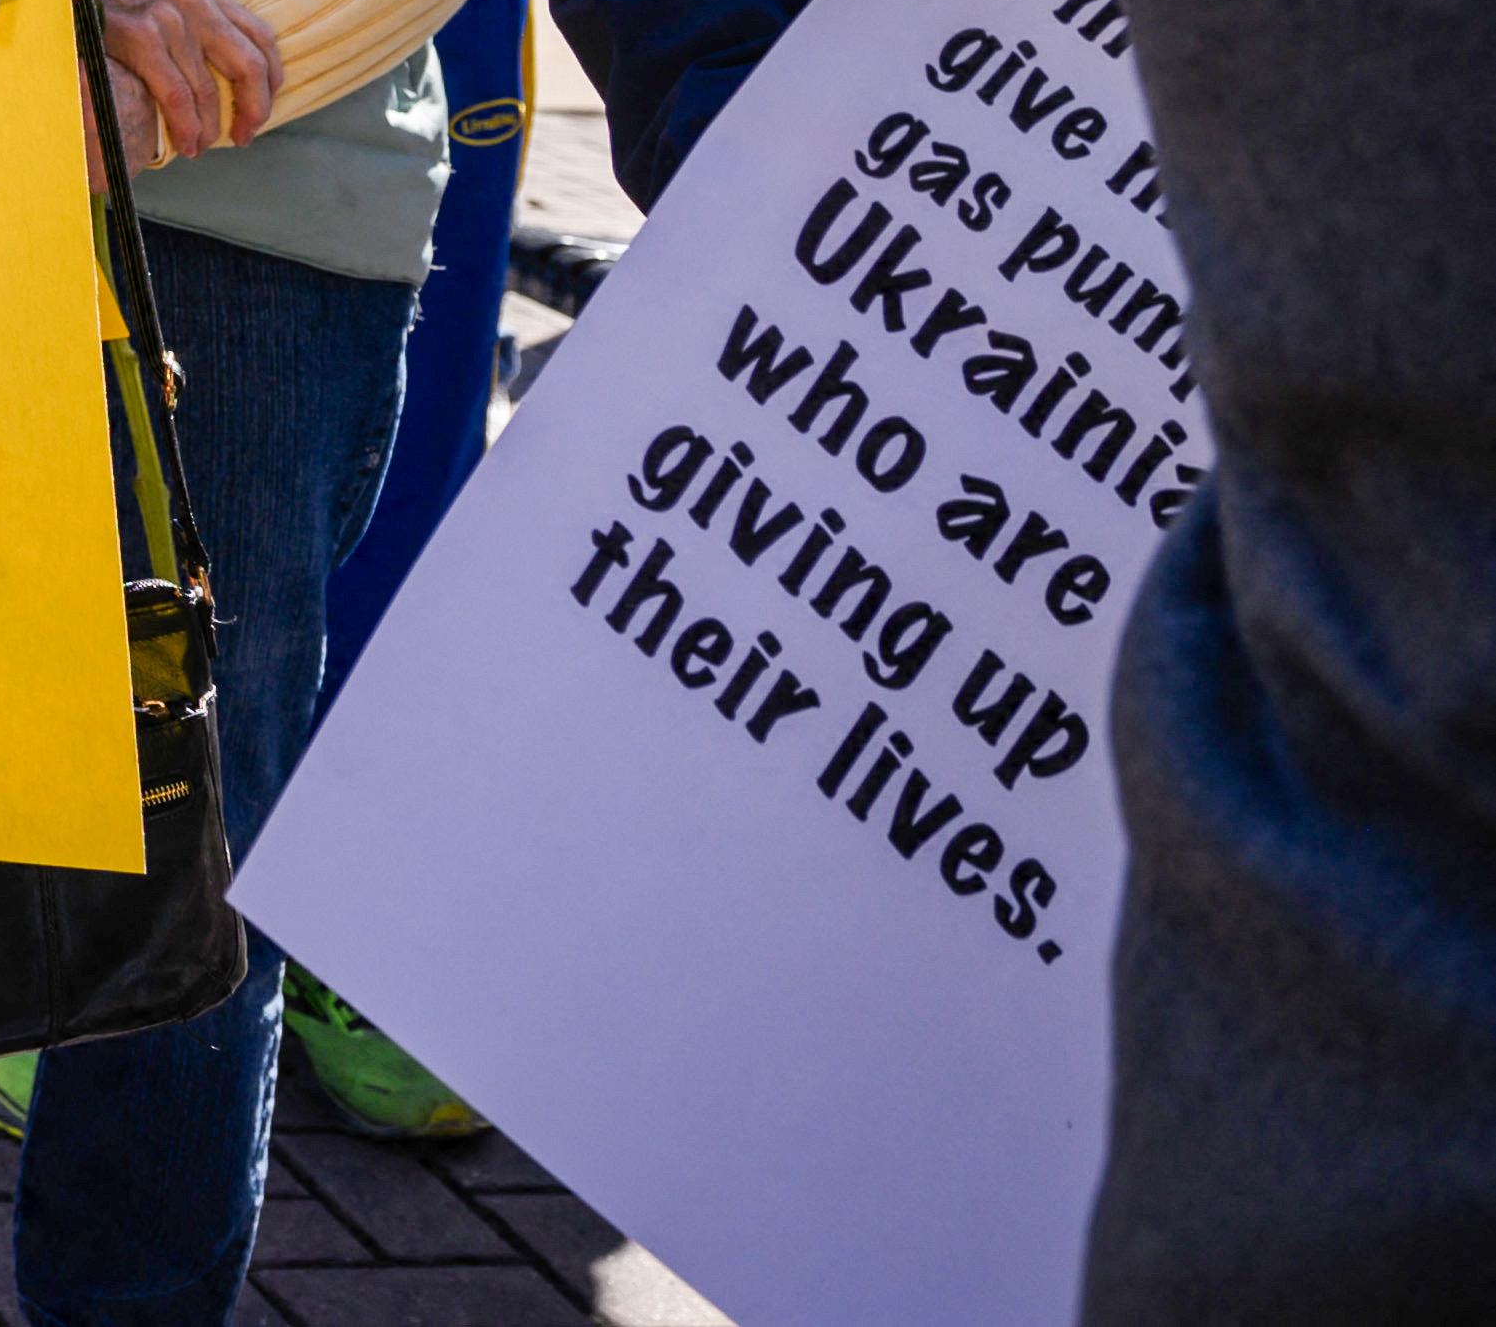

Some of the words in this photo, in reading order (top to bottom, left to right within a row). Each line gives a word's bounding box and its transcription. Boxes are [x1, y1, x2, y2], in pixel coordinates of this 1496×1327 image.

[854, 111, 1012, 233] gas
[925, 27, 1108, 160] give
[627, 425, 954, 691] giving
[951, 648, 1090, 791] up
[717, 304, 927, 493] who
[935, 473, 1111, 627] are
[570, 520, 821, 744] their
[816, 701, 1064, 966] lives.
